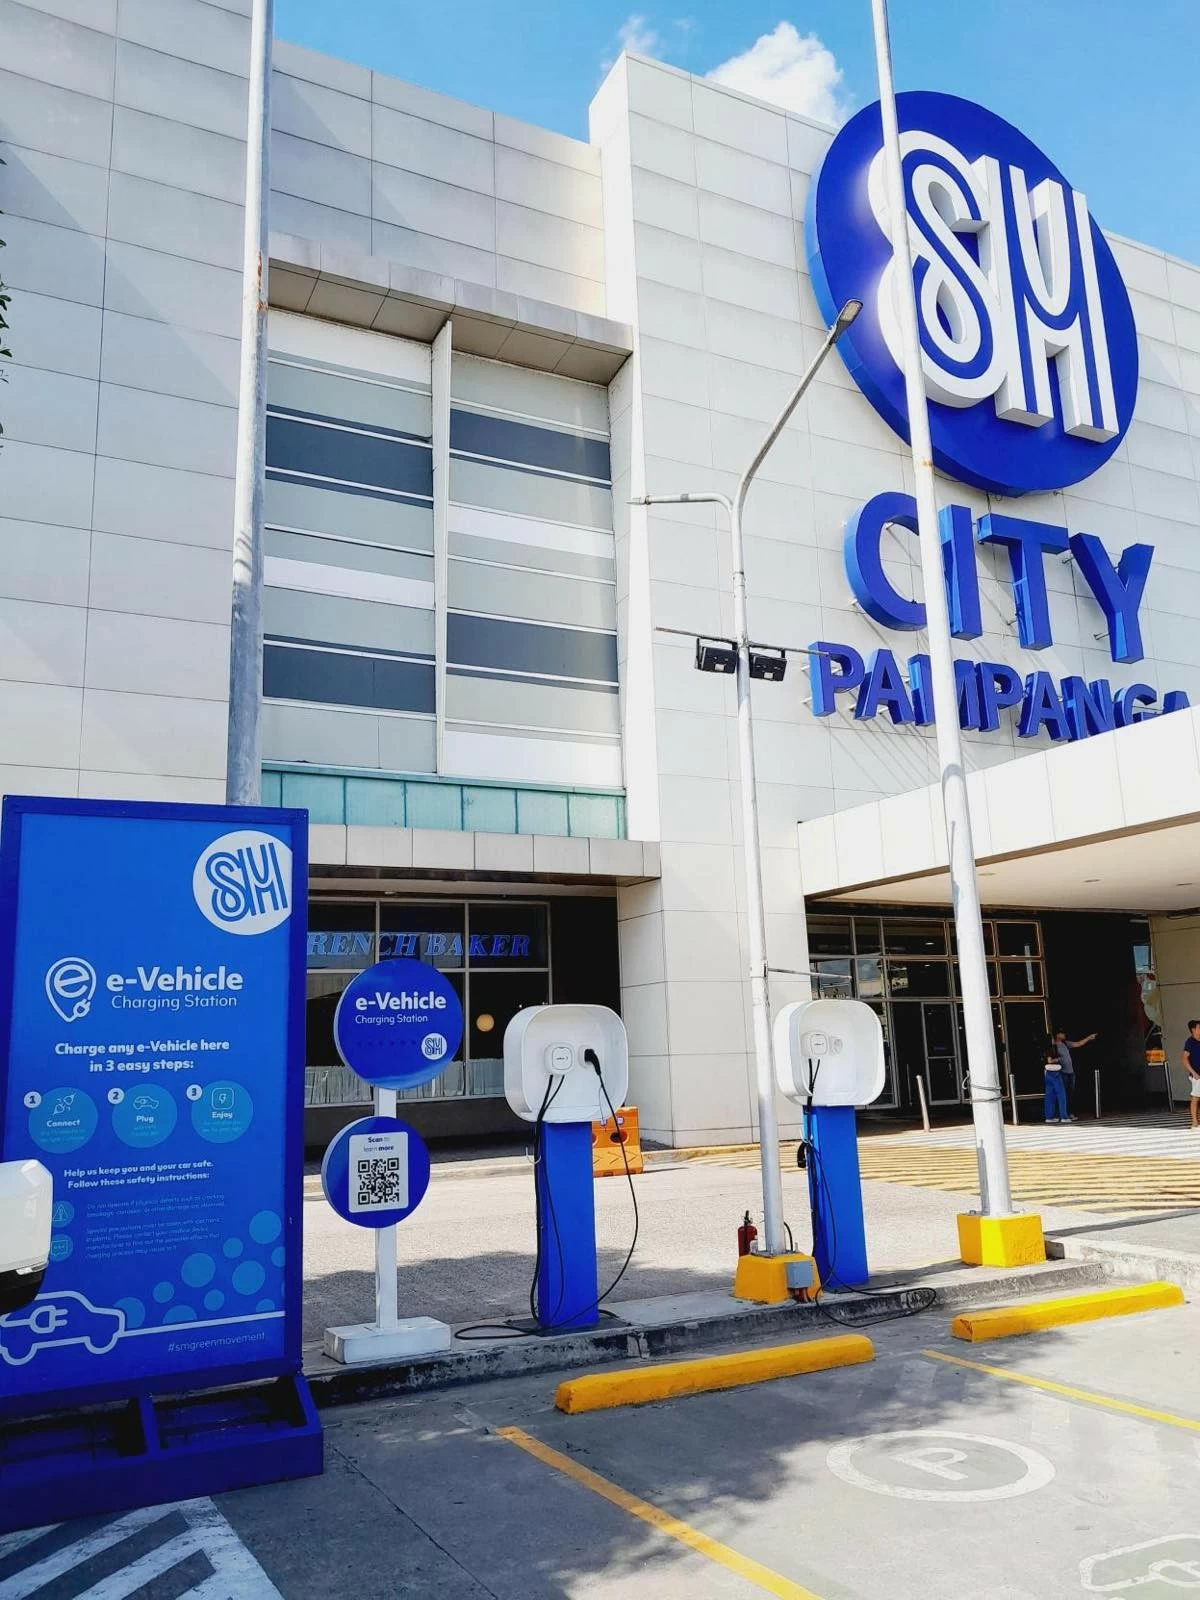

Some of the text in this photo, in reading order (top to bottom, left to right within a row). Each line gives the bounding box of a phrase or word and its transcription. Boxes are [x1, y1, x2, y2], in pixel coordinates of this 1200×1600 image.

[868, 130, 1119, 443] SM
[842, 491, 1155, 664] CITY
[205, 842, 289, 922] SM
[424, 933, 530, 957] BAKER
[106, 965, 244, 992] e-Vehicle
[111, 994, 238, 1012] Charging Station
[355, 990, 447, 1011] e-Vehicle
[355, 1013, 429, 1026] Charging Station
[55, 1038, 230, 1057] Charge any e-Vehicle here
[424, 1037, 443, 1056] SM
[89, 1058, 195, 1074] in 3 easy steps:
[29, 1095, 36, 1105] 1
[112, 1091, 119, 1100] 2
[191, 1087, 198, 1097] 3
[46, 1119, 81, 1128] Connect
[136, 1115, 154, 1124] Plug
[211, 1111, 233, 1120] Enjoy
[63, 1159, 214, 1179] Help us keep you and your car safe.
[67, 1171, 210, 1190] Follow these safety instructions:
[167, 1331, 266, 1353] #smgreenmovement
[889, 1447, 969, 1481] P
